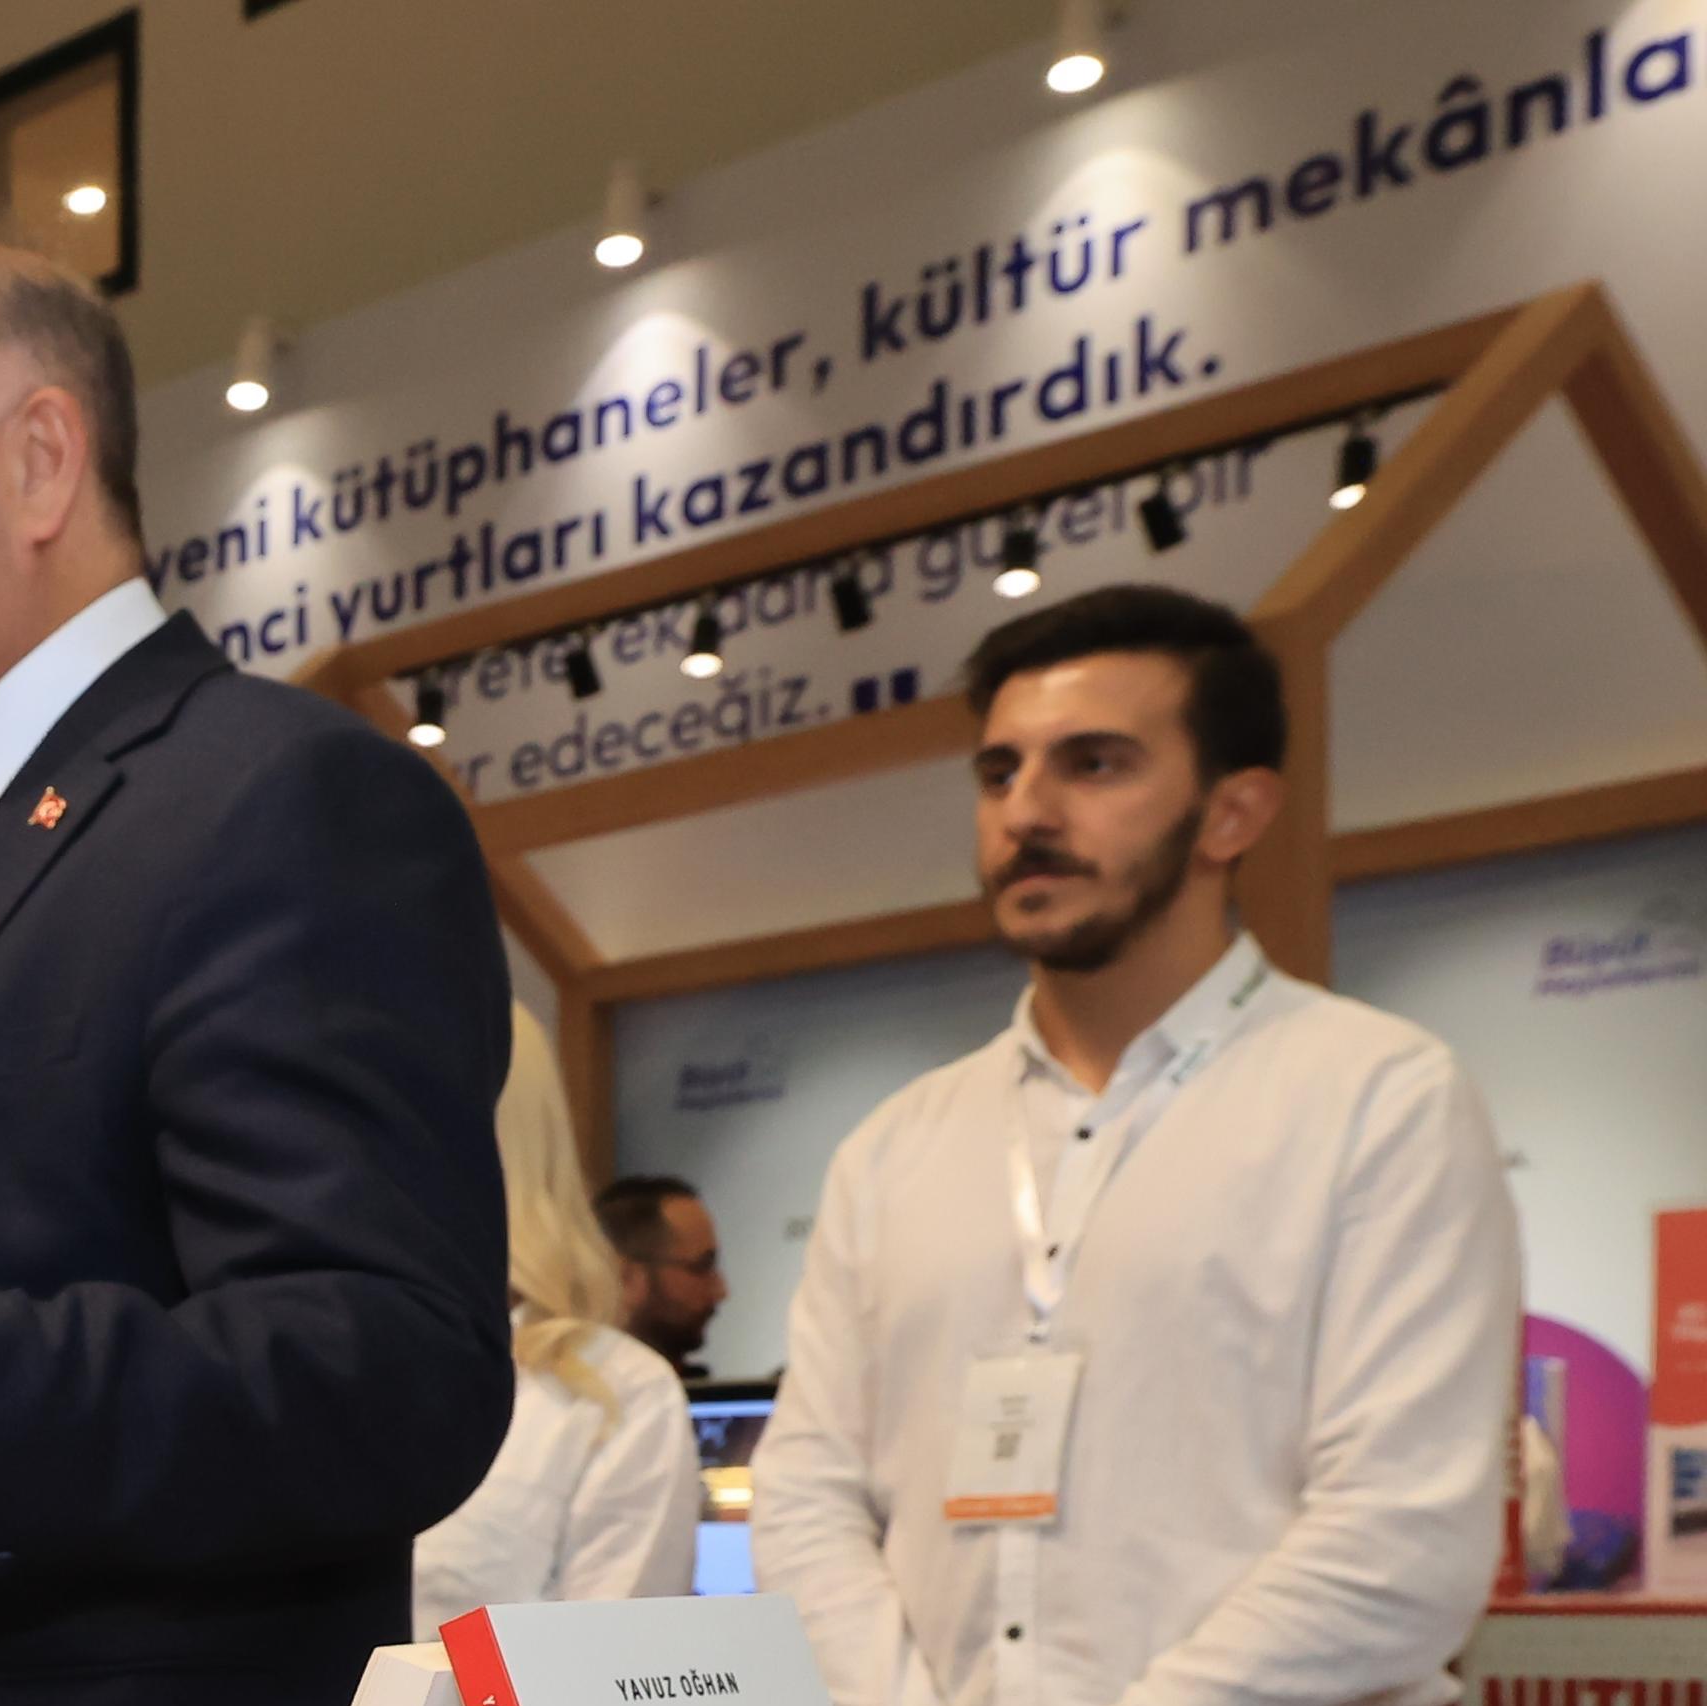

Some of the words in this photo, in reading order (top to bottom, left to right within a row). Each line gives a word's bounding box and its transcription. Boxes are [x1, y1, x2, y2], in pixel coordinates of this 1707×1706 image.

[293, 332, 833, 548] kütüphaneler,
[862, 216, 1145, 362] kültür
[1187, 29, 1691, 254] mekânla
[328, 512, 606, 642] yurtları
[634, 316, 1223, 546] kazandırdık.
[509, 667, 829, 787] edeceğiz.
[615, 1673, 677, 1702] YAVUZ
[679, 1668, 741, 1699] OĞHAN
